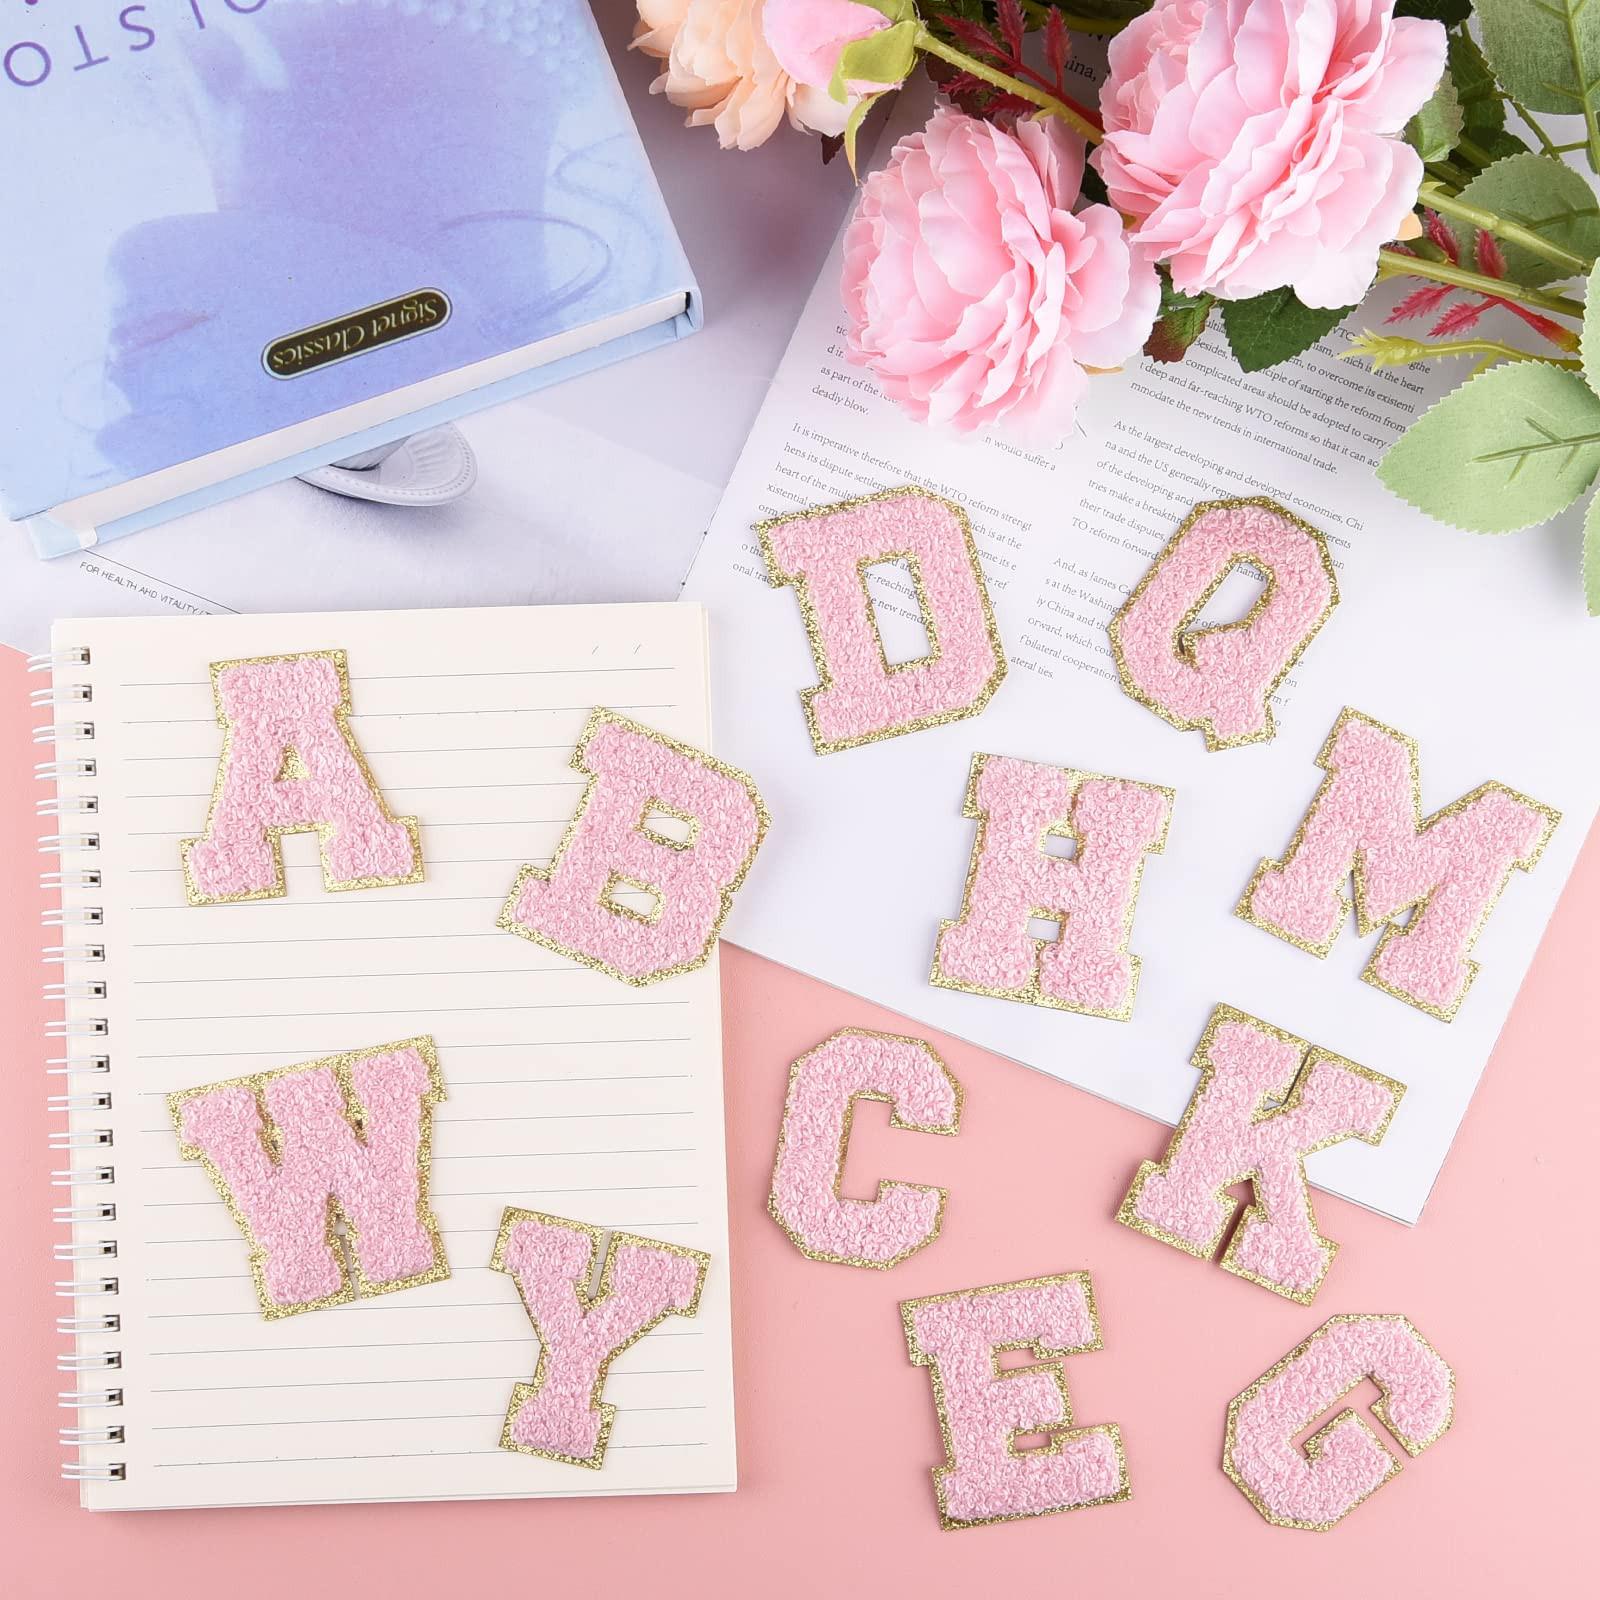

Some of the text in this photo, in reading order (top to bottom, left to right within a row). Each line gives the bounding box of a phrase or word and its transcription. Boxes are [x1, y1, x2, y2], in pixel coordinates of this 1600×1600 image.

[273, 299, 438, 368] Signet Classics
[812, 384, 869, 416] deadly blow.
[820, 366, 879, 396] as part of the
[1185, 359, 1243, 388] complicated
[1243, 380, 1267, 398] areas
[1267, 391, 1300, 412] should
[1300, 404, 1312, 417] be
[1312, 410, 1351, 435] adopted
[1351, 426, 1362, 437] to
[1362, 432, 1387, 450] carry
[1288, 378, 1301, 390] of
[1300, 383, 1334, 405] starting
[1334, 396, 1350, 409] the
[1350, 404, 1382, 424] reform
[1382, 416, 1406, 434] from
[1307, 363, 1317, 373] to
[1318, 368, 1364, 393] overcome
[1364, 385, 1376, 398] its
[1376, 391, 1416, 414] existenti
[1374, 367, 1384, 377] at
[1384, 371, 1400, 384] the
[1400, 377, 1425, 395] heart
[1130, 383, 1339, 475] mmodate the new trends in international trade.
[1145, 364, 1168, 382] deep
[1168, 373, 1188, 388] and
[1187, 380, 1244, 413] far-reaching
[1245, 404, 1273, 424] WTO
[1273, 419, 1309, 439] reforms
[1309, 434, 1321, 444] so
[1322, 438, 1341, 453] that
[1341, 445, 1349, 456] it
[1349, 450, 1368, 464] can
[792, 422, 801, 433] It
[802, 426, 810, 437] is
[811, 431, 859, 458] imperative
[860, 449, 902, 475] therefore
[903, 465, 922, 483] that
[923, 475, 939, 491] the
[940, 483, 967, 504] WTO
[968, 498, 999, 517] reform
[1001, 510, 1033, 532] strengt
[994, 438, 1022, 458] would
[1023, 449, 1049, 470] suffer
[1096, 460, 1110, 471] of
[1108, 463, 1124, 477] the
[1123, 470, 1175, 501] developing
[1174, 494, 1194, 507] and
[1104, 440, 1211, 492] na and the US generally
[1113, 420, 1126, 432] As
[1128, 425, 1143, 439] the
[1143, 432, 1174, 452] largest
[1173, 445, 1225, 476] developing
[1224, 467, 1244, 481] and
[1244, 475, 1292, 501] developed
[1292, 495, 1345, 525] economies,
[1346, 516, 1364, 531] Chi
[758, 503, 779, 517] orm
[767, 483, 808, 506] xistential
[775, 461, 800, 481] heart
[800, 473, 815, 486] of
[813, 478, 828, 491] the
[999, 556, 1010, 568] its
[784, 442, 806, 459] hens
[806, 450, 818, 464] its
[819, 457, 854, 479] dispute
[988, 528, 996, 539] is
[996, 533, 1006, 543] at
[1007, 536, 1023, 551] the
[1088, 479, 1108, 494] tries
[1108, 488, 1135, 505] make
[1134, 499, 1141, 508] a
[1072, 517, 1089, 531] TO
[1089, 526, 1121, 544] reform
[1079, 498, 1265, 582] their trade disputes, hands
[80, 561, 100, 575] FOR
[101, 570, 138, 591] HEALTH
[160, 594, 199, 615] VITALITY
[732, 562, 754, 577] onal
[1051, 581, 1062, 589] at
[1061, 583, 1077, 596] the
[1053, 557, 1077, 574] And,
[1078, 568, 1089, 578] as
[1089, 571, 1117, 590] James
[754, 486, 1008, 755] D
[878, 600, 898, 613] new
[1027, 617, 1093, 649] orward, which
[1046, 600, 1075, 619] China
[1076, 614, 1096, 627] and
[1108, 494, 1341, 753] Q
[1010, 655, 1038, 672] ateral
[1025, 636, 1062, 659] bilateral
[1062, 653, 1118, 682] cooperation
[181, 648, 426, 906] A
[496, 706, 772, 988] B
[1233, 705, 1563, 1023] M
[928, 751, 1177, 1022] H
[167, 1034, 450, 1322] W
[766, 1026, 966, 1272] C
[1114, 1002, 1407, 1306] K
[489, 1205, 712, 1470] Y
[897, 1269, 1133, 1532] E
[1221, 1312, 1459, 1533] G
